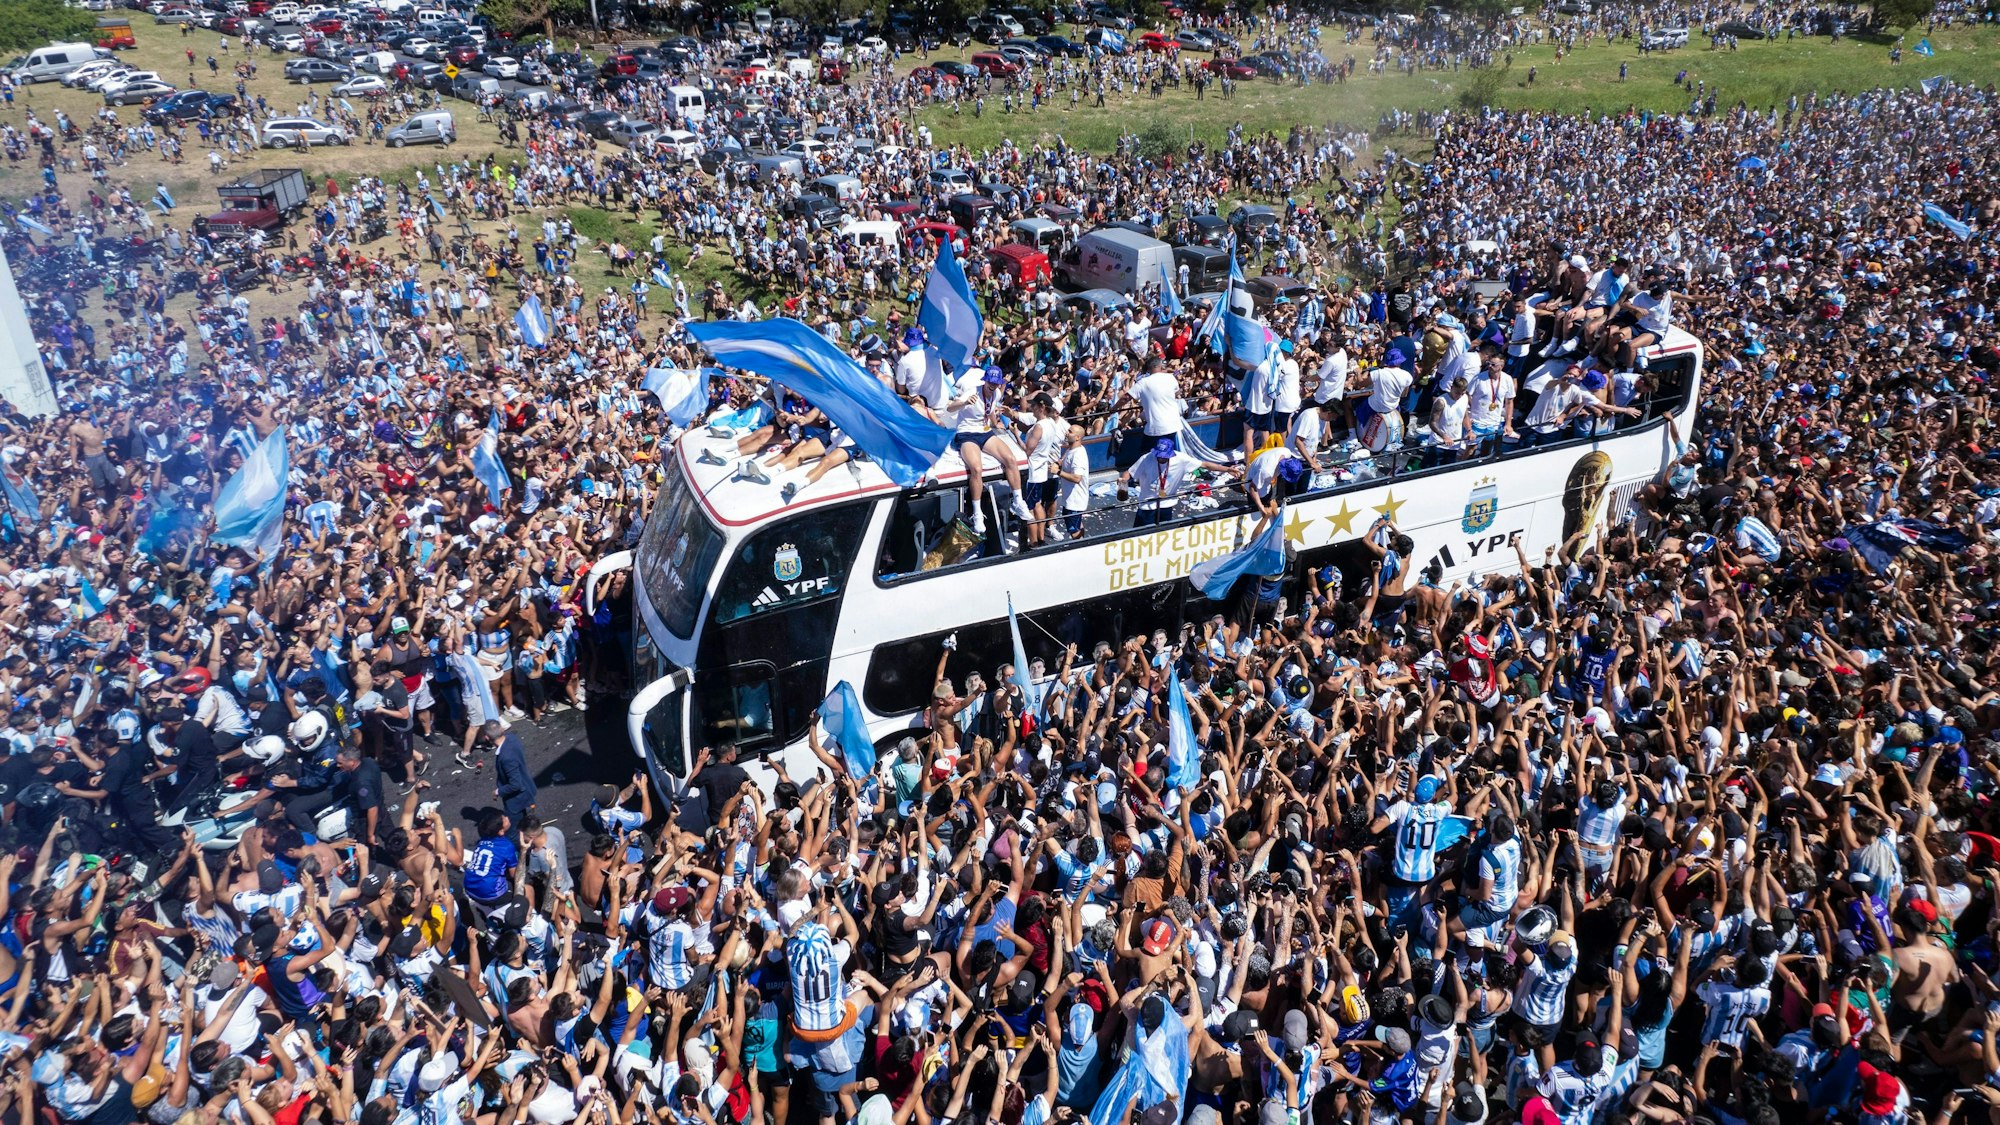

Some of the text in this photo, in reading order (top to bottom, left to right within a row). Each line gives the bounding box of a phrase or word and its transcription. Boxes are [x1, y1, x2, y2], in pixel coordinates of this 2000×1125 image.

[1467, 529, 1524, 557] YPF
[670, 567, 685, 591] YPF
[784, 576, 829, 596] YPF
[1109, 562, 1154, 592] DEL
[1584, 661, 1603, 680] 10
[1034, 694, 1041, 703] 8
[1405, 818, 1436, 849] 10
[467, 847, 494, 877] 10
[803, 969, 830, 1004] 10
[1732, 1001, 1757, 1011] MESSI
[1723, 1013, 1752, 1035] 10
